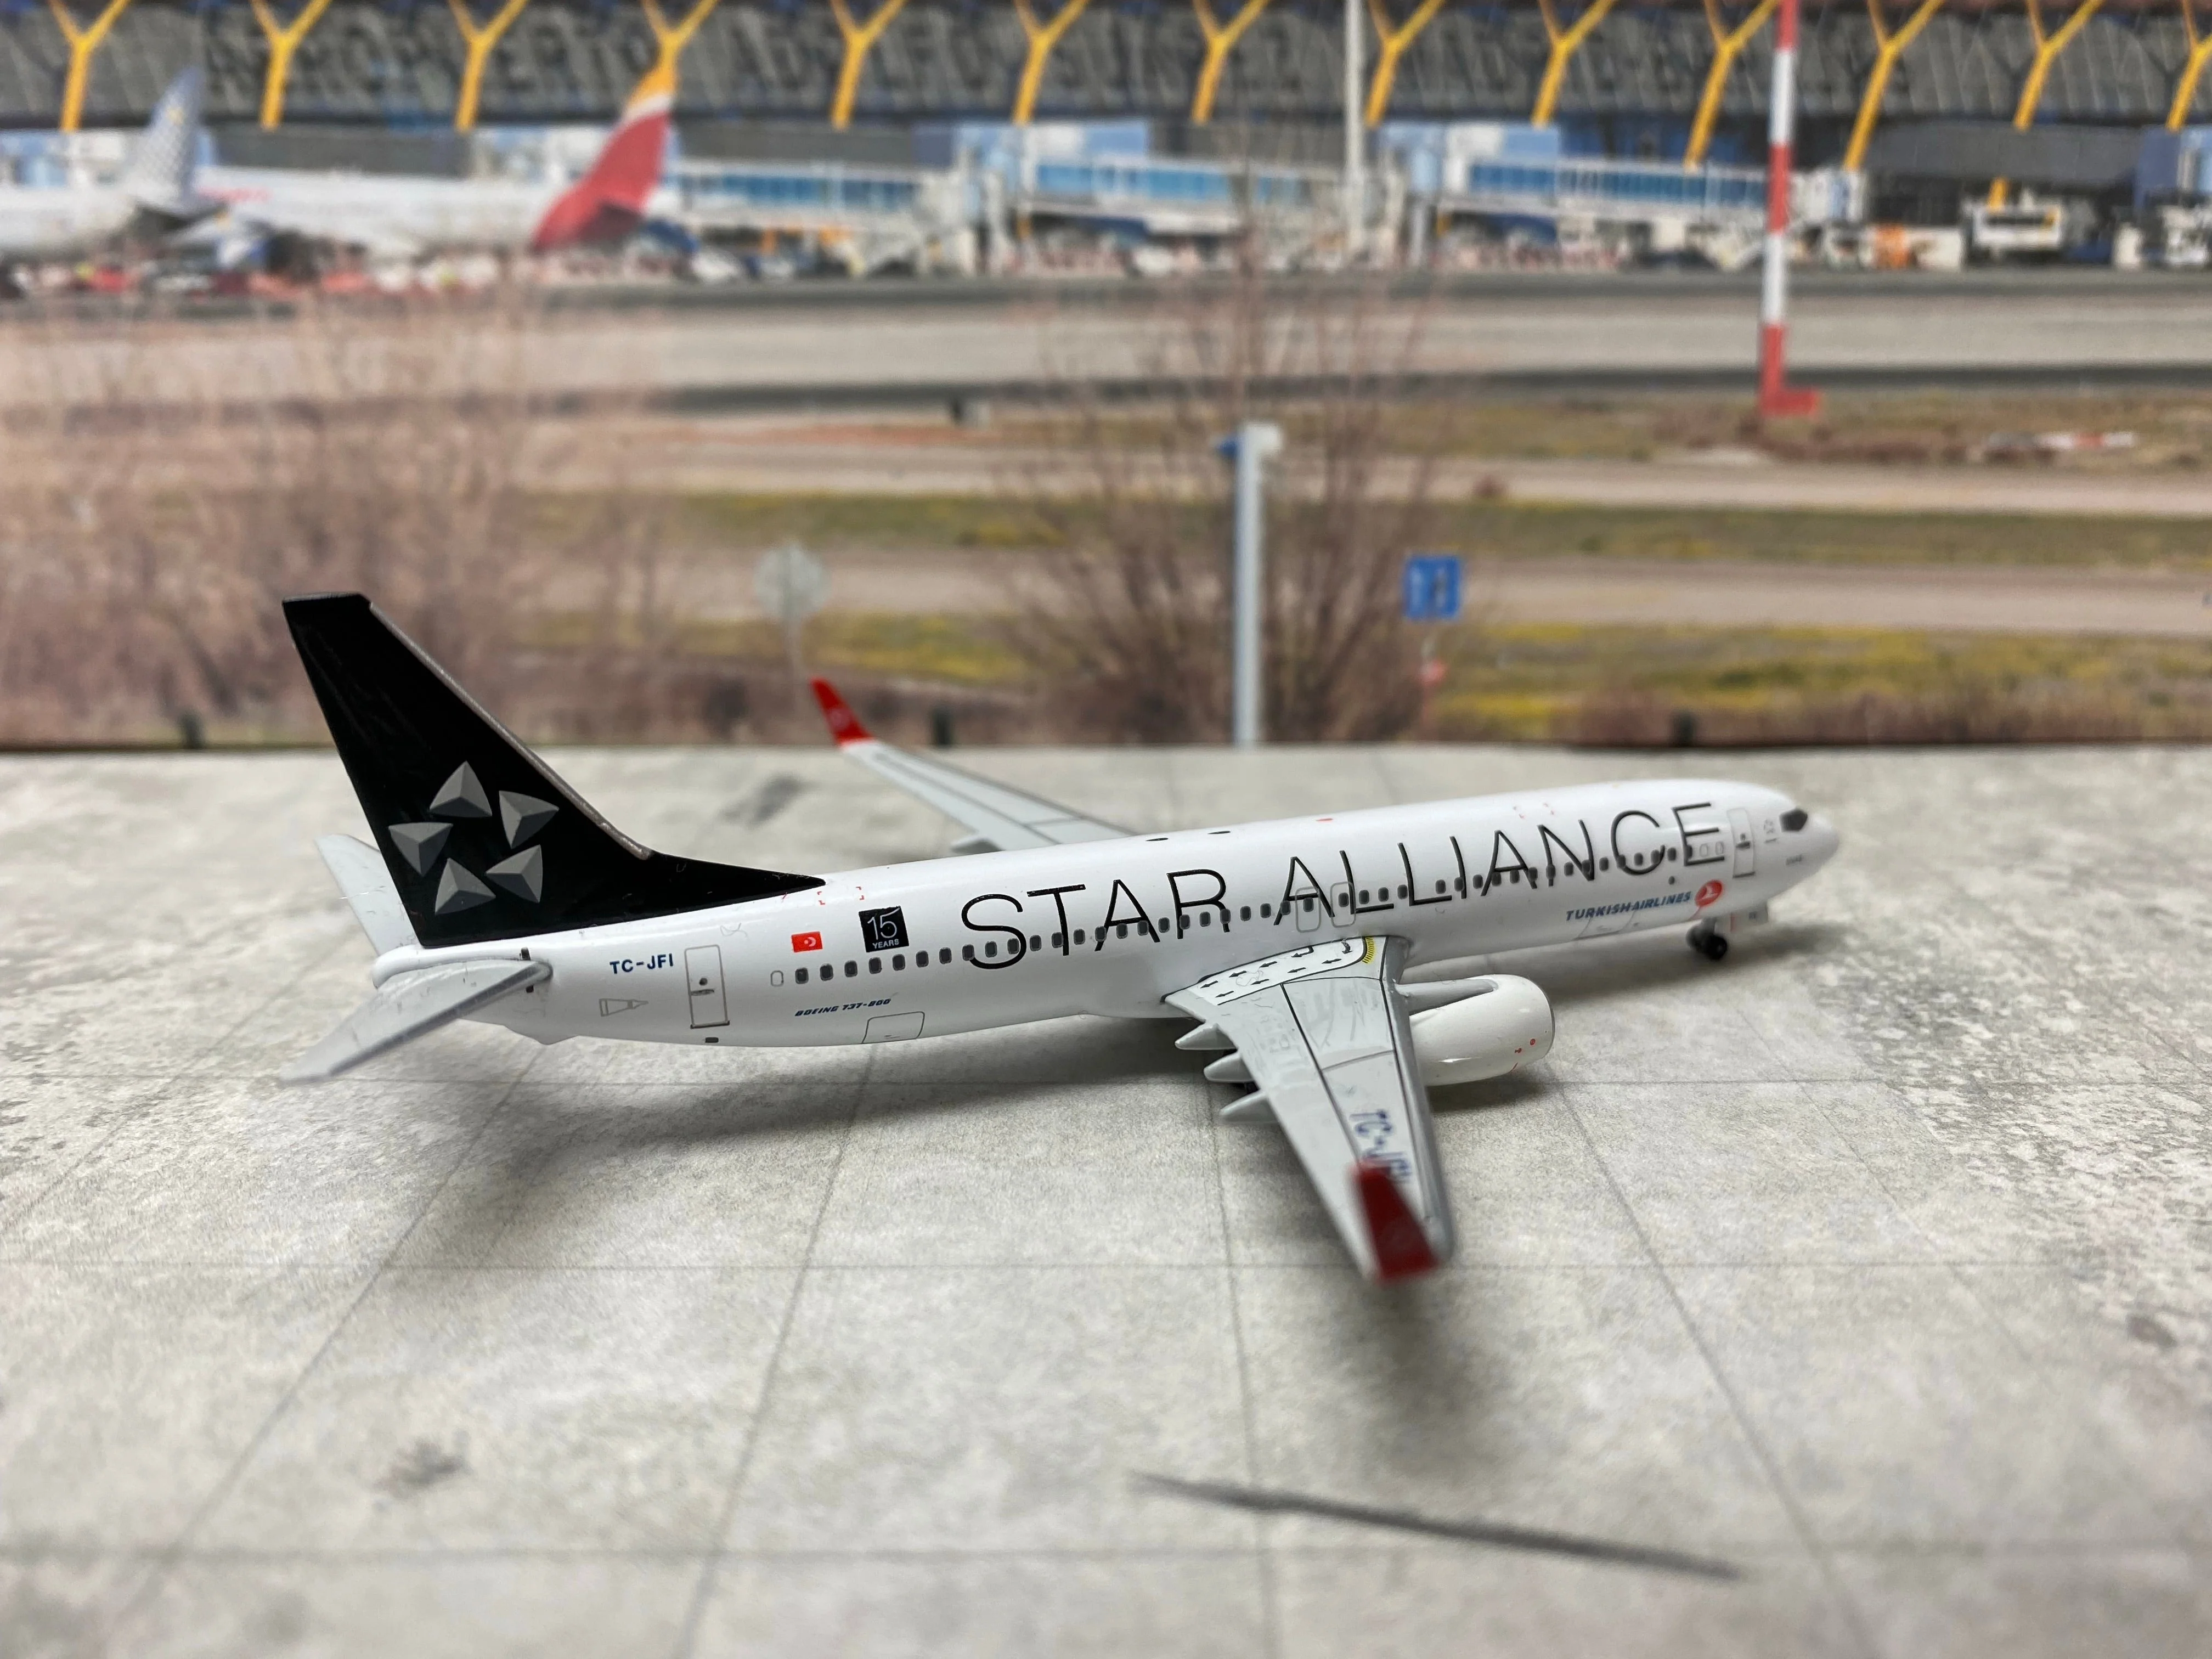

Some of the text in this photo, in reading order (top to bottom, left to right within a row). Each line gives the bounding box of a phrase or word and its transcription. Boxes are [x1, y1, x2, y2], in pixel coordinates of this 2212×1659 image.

[961, 802, 1725, 969] STAR ALLIANCE
[867, 907, 900, 940] 15
[872, 939, 900, 949] YEARS
[610, 953, 674, 974] TC-JFI
[795, 998, 891, 1017] BOEING 737-800
